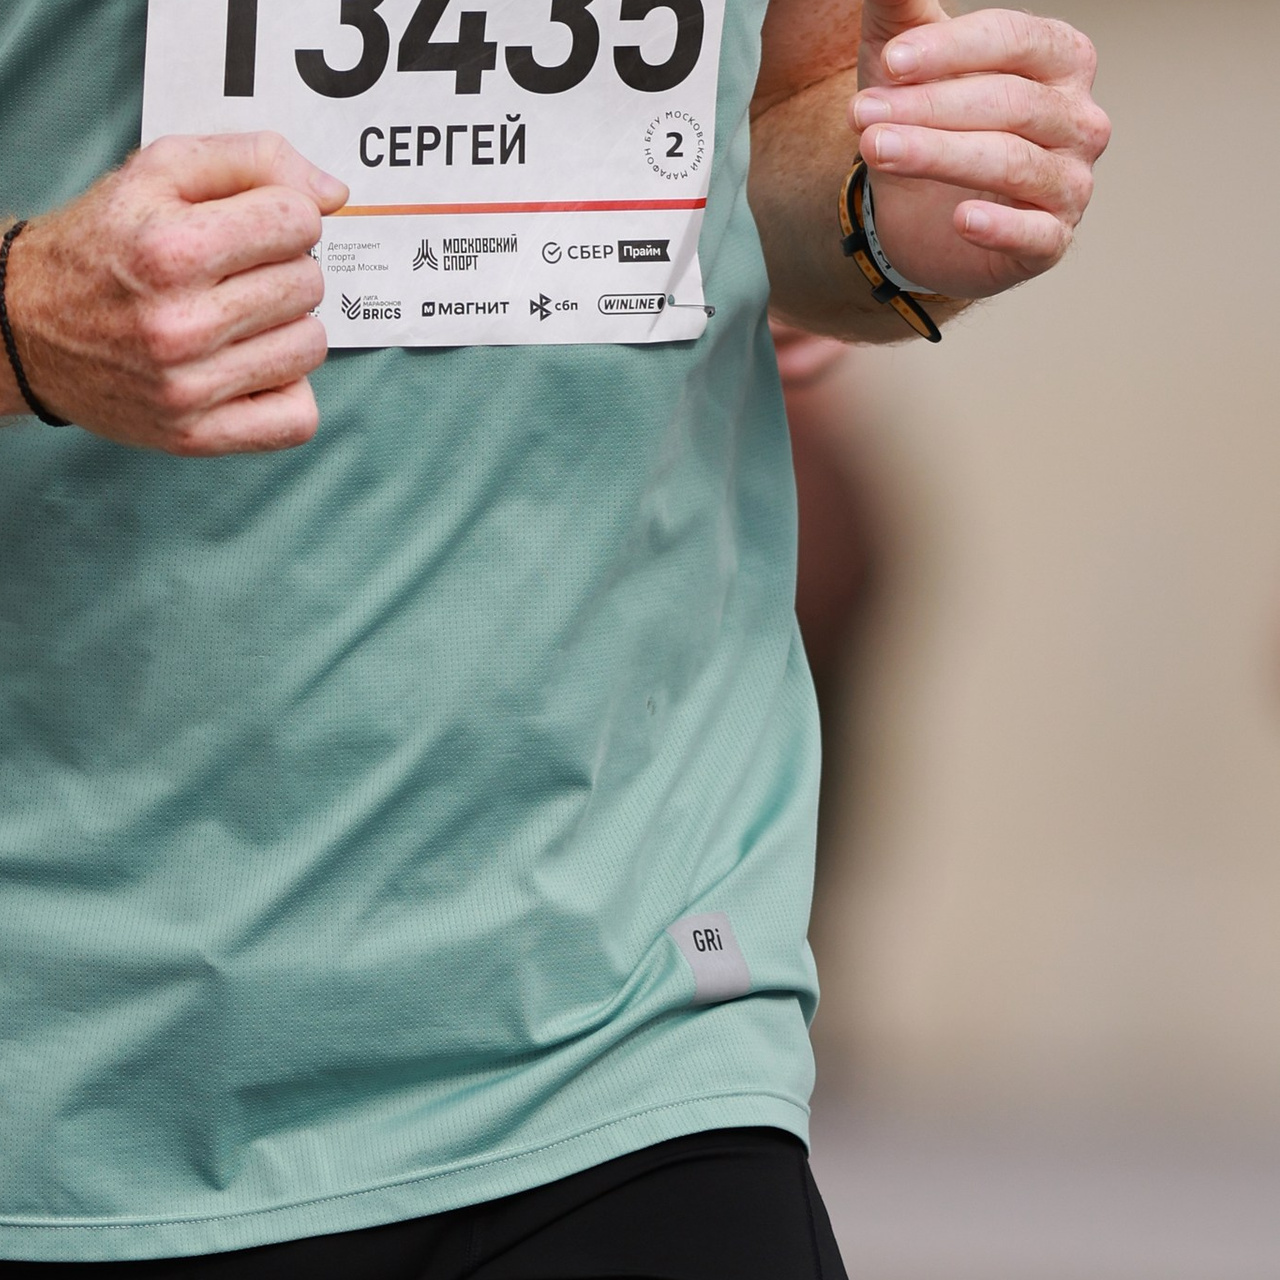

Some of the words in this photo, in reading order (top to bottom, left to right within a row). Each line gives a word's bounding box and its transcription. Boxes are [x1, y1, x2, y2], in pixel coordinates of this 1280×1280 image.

[359, 113, 527, 168] СЕРГЕЙ
[665, 131, 684, 158] 2
[327, 241, 381, 252] Департамент
[443, 233, 518, 254] МОСКОВСКИЙ
[327, 254, 356, 263] спорта
[567, 244, 614, 260] СБЕР
[623, 244, 661, 259] Прайм
[327, 265, 356, 274] города
[357, 263, 389, 272] Москвы
[443, 254, 479, 271] СПОРТ
[438, 301, 510, 316] магнит
[554, 299, 579, 311] сбп
[604, 298, 656, 311] WINLINE
[362, 307, 402, 321] BRICS
[692, 928, 723, 952] GRi
